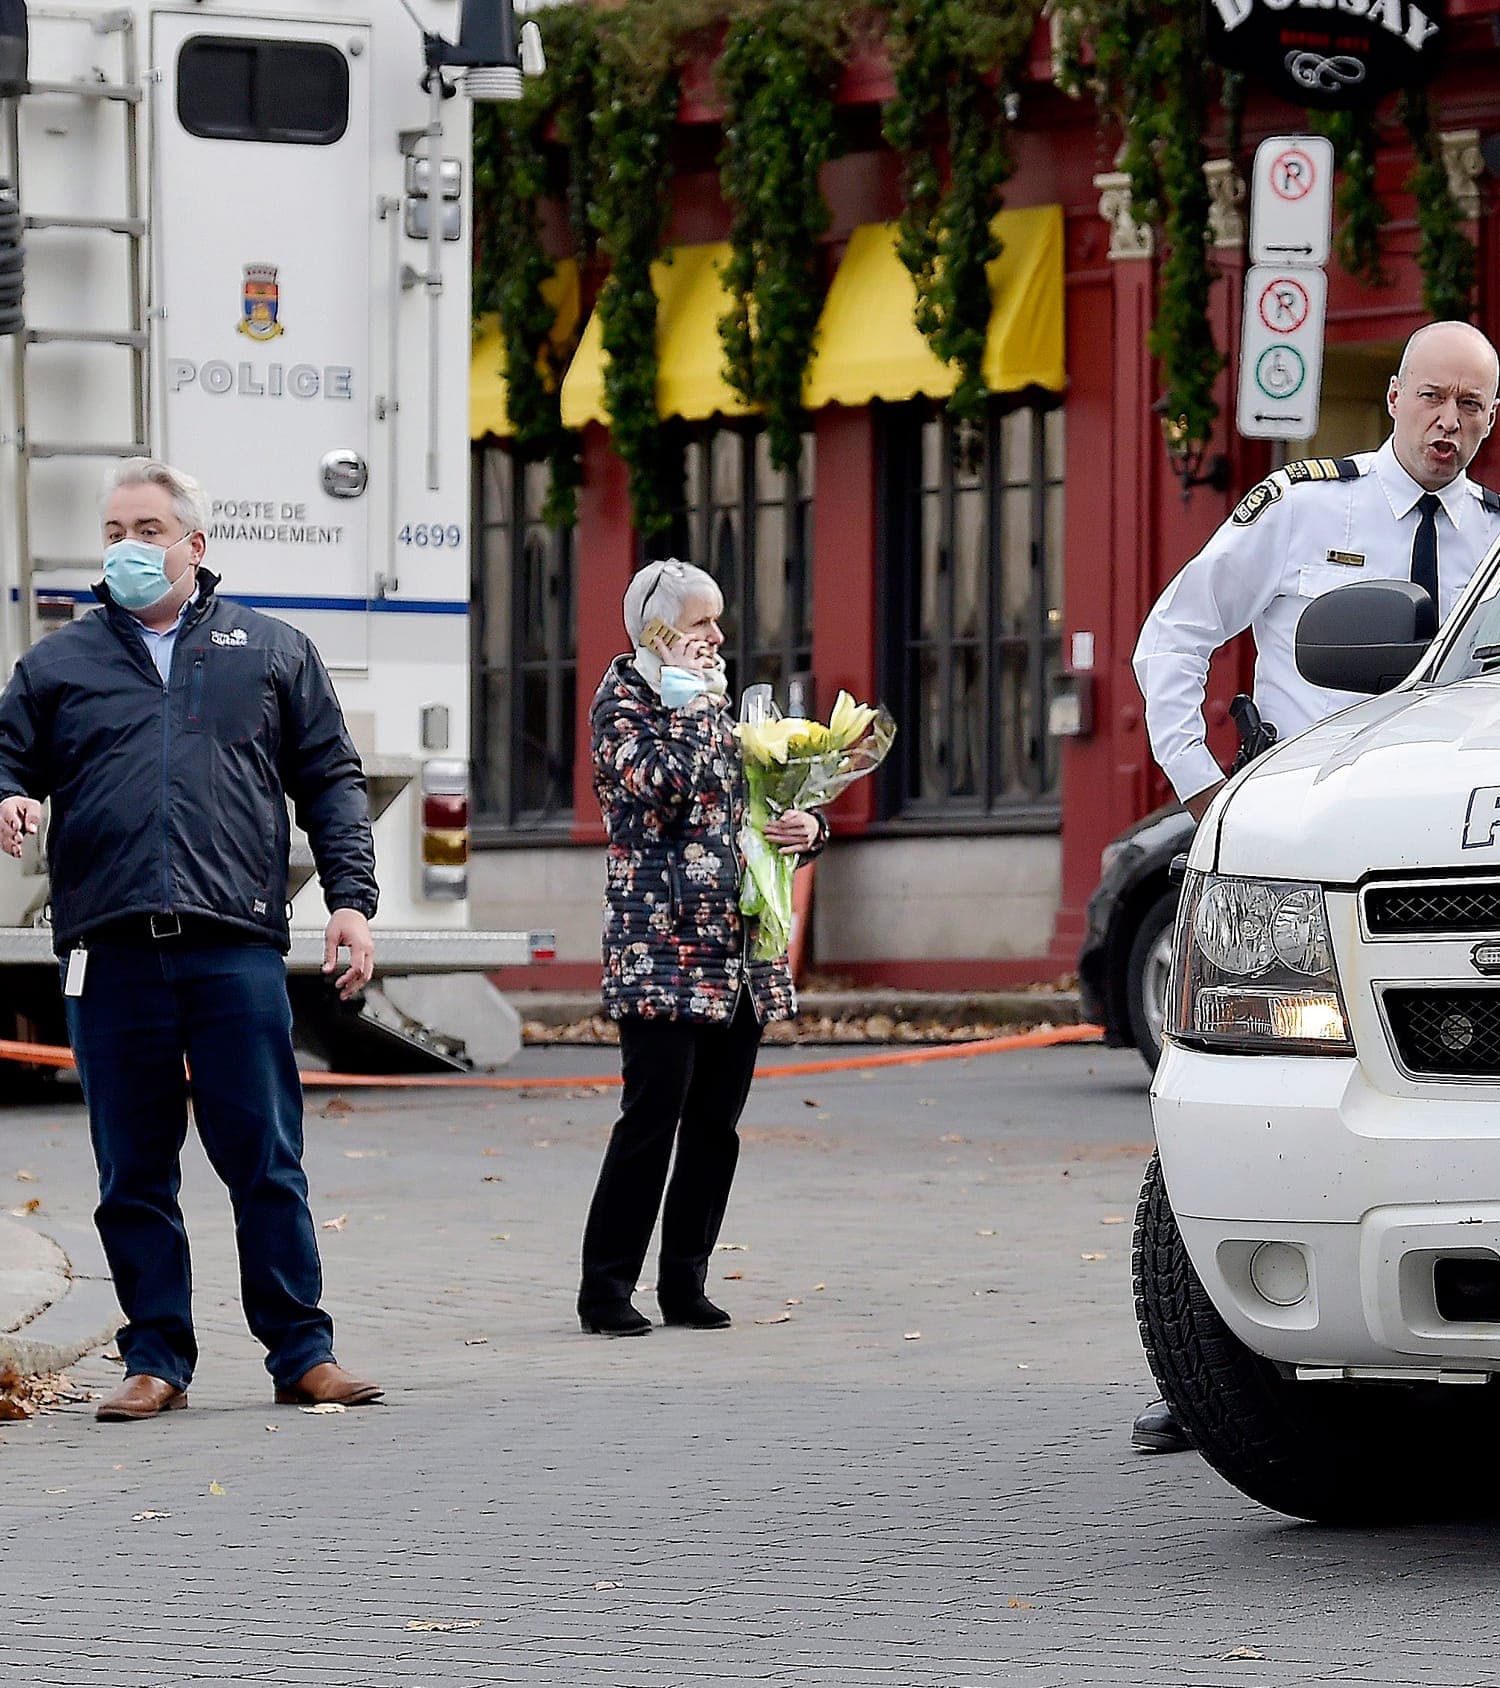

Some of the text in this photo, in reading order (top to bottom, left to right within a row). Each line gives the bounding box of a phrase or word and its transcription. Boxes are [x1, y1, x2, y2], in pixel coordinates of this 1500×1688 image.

[167, 358, 352, 399] POLICE
[211, 500, 307, 520] POSTE DE
[398, 524, 461, 547] 4699
